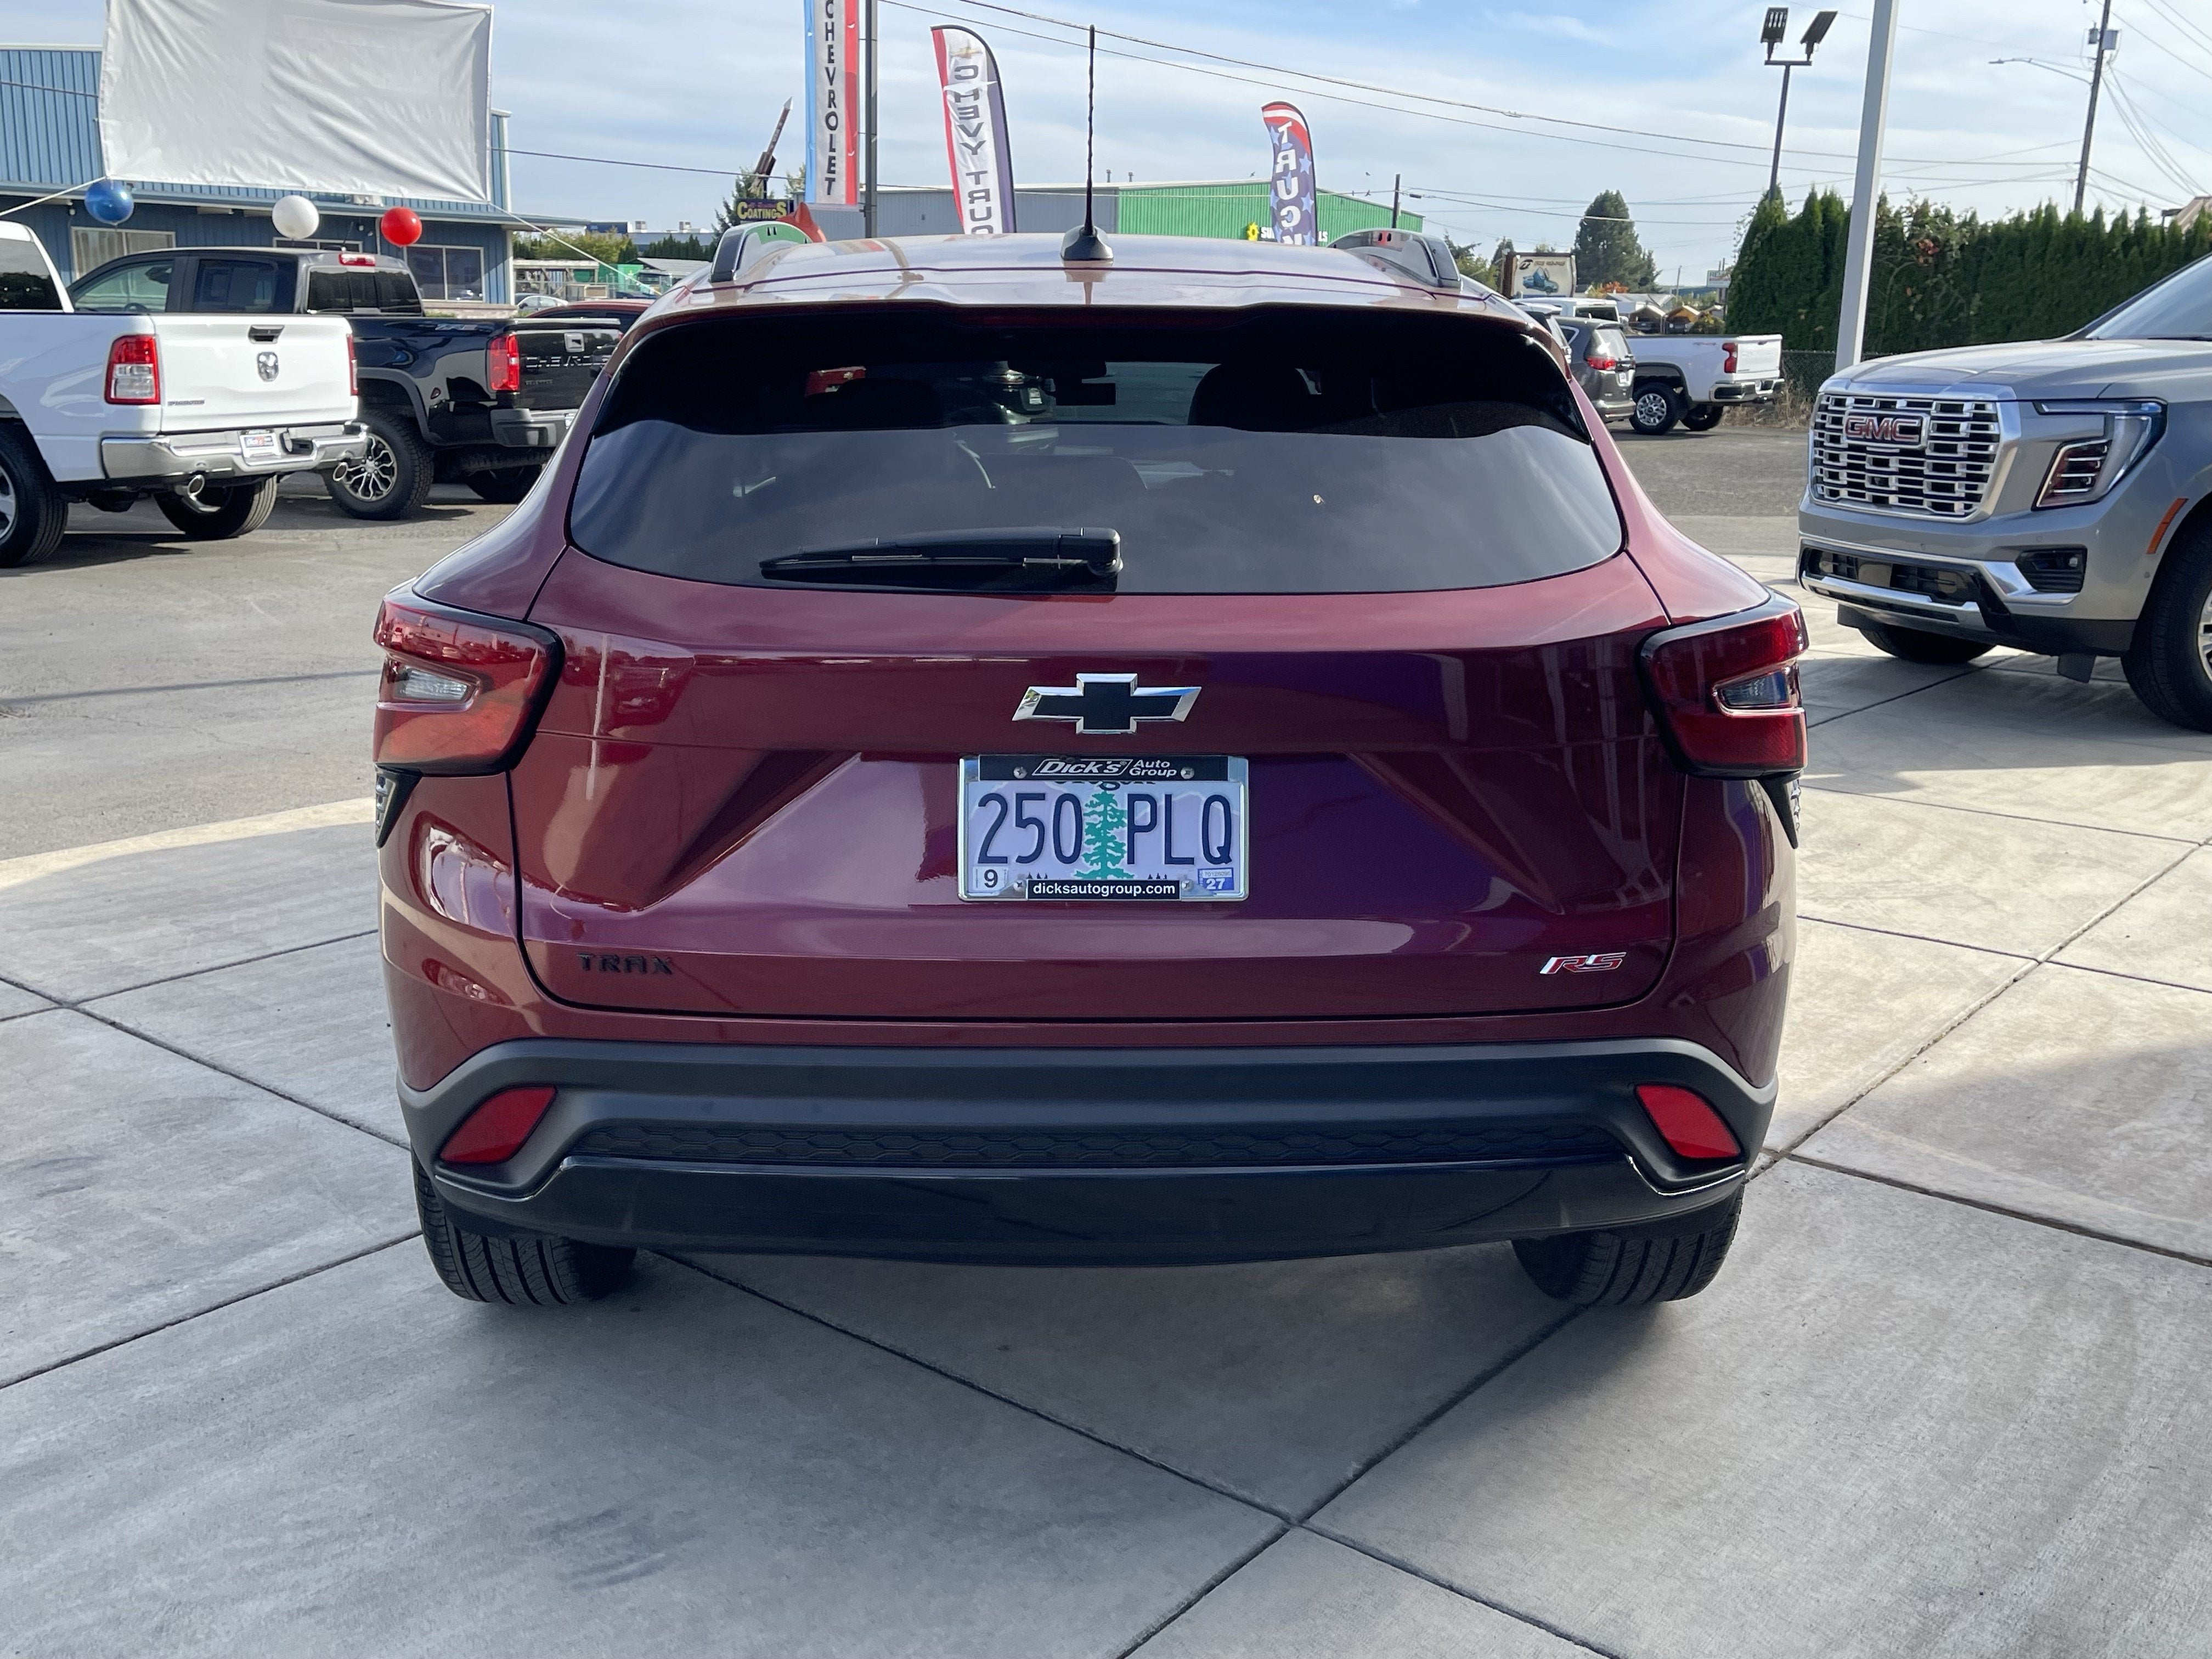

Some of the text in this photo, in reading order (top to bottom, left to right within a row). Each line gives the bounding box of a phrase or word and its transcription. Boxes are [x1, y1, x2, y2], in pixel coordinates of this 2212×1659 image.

[824, 0, 839, 196] CHEVROLET
[737, 201, 787, 219] COATINGS
[526, 355, 613, 368] CHEVROLE
[1845, 415, 1920, 442] GMC
[1133, 759, 1171, 768] Auto
[1129, 768, 1177, 778] Group
[978, 793, 1233, 865] 250 PLQ
[984, 869, 998, 888] 9
[1206, 878, 1226, 890] 27
[1032, 882, 1176, 897] dicksautogroup.com
[577, 952, 673, 975] TRAX
[1539, 952, 1627, 974] RS
